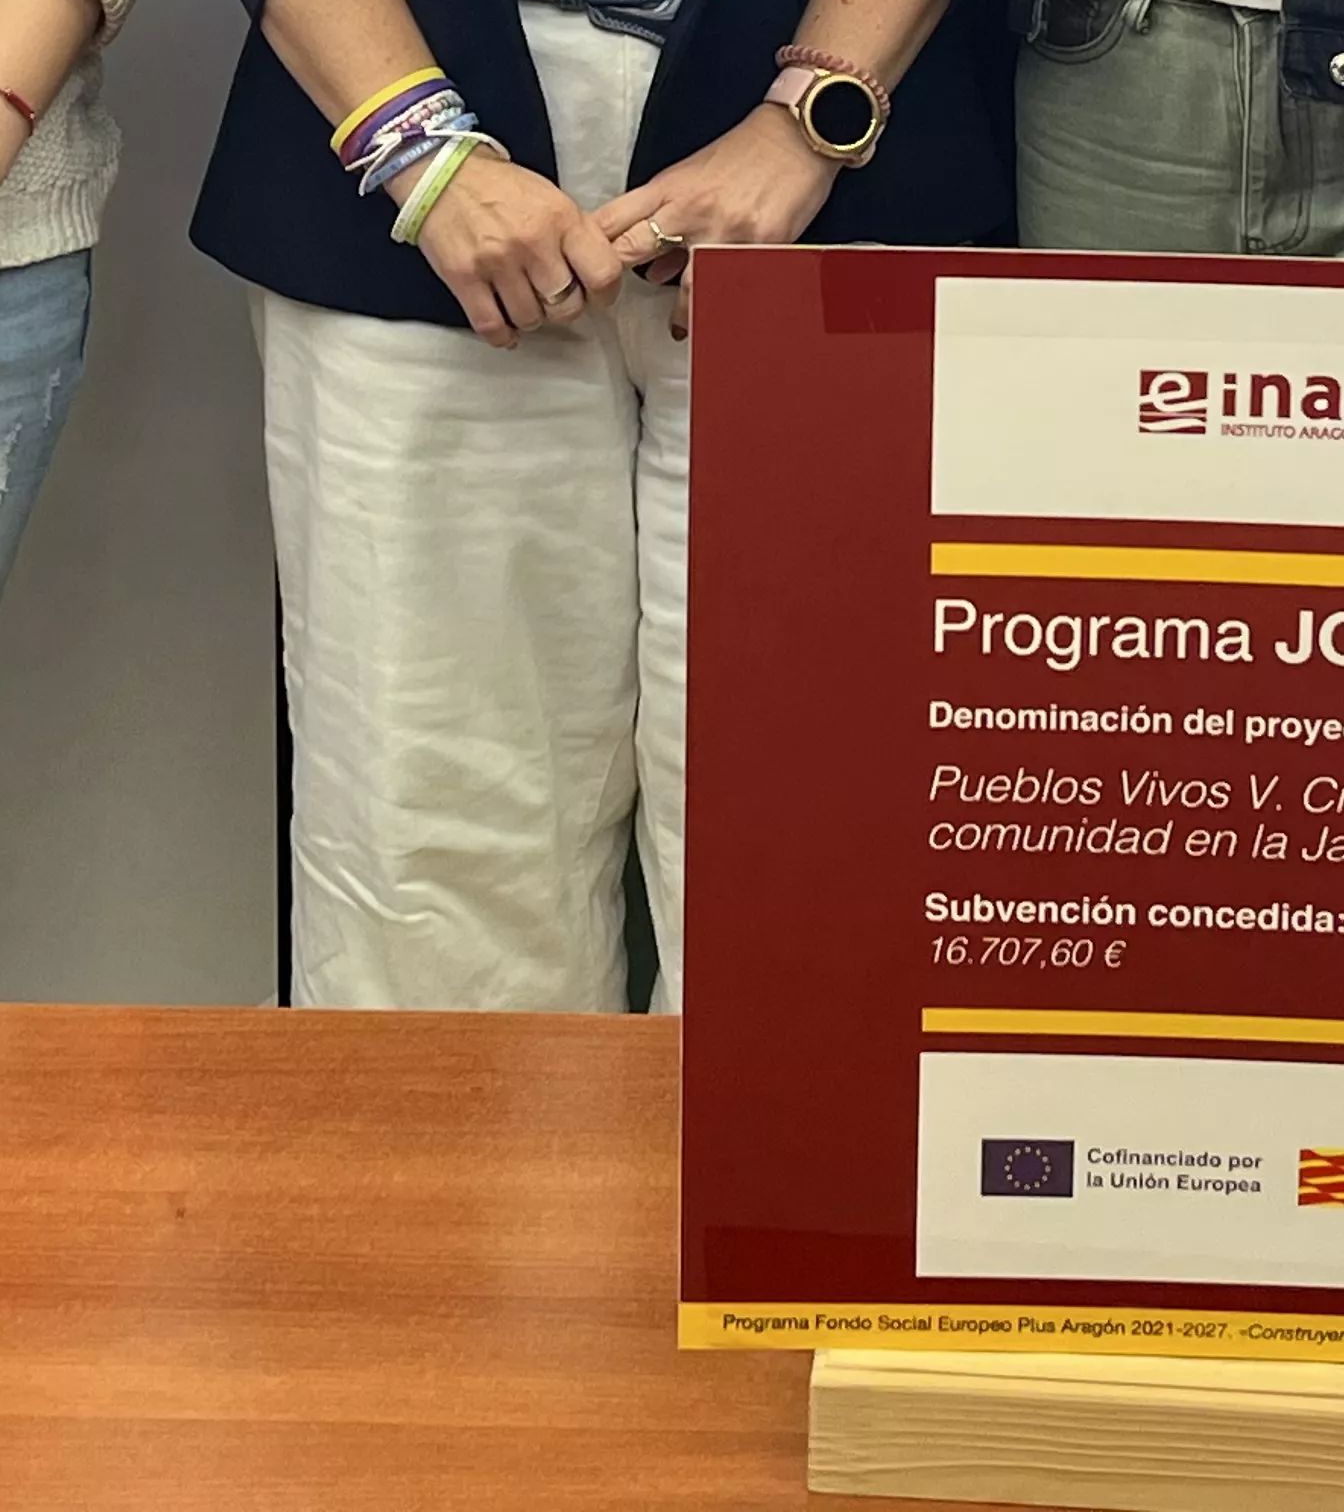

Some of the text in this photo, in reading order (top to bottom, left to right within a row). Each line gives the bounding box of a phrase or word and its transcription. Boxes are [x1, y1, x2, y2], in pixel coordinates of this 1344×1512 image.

[1221, 423, 1296, 439] INSTITUTO
[933, 598, 1254, 672] Programa
[929, 700, 1173, 735] Denominación
[1183, 708, 1236, 737] del
[929, 765, 1104, 806] Pueblos
[1120, 769, 1233, 810] Vivos
[1249, 773, 1283, 812] V.
[928, 817, 1173, 856] comunidad
[1184, 829, 1238, 858] en
[1251, 823, 1289, 860] la
[925, 892, 1136, 926] Subvención
[931, 935, 1127, 970] 16.707,60 €
[1087, 1148, 1263, 1174] Cofinanciado por
[1086, 1171, 1262, 1196] la Unión Europea
[722, 1313, 810, 1334] Programa
[815, 1313, 873, 1332] Fondo
[877, 1314, 933, 1333] Social
[938, 1315, 1013, 1336] Europeo
[1017, 1316, 1056, 1335] Plus
[1060, 1318, 1126, 1339] Aragón
